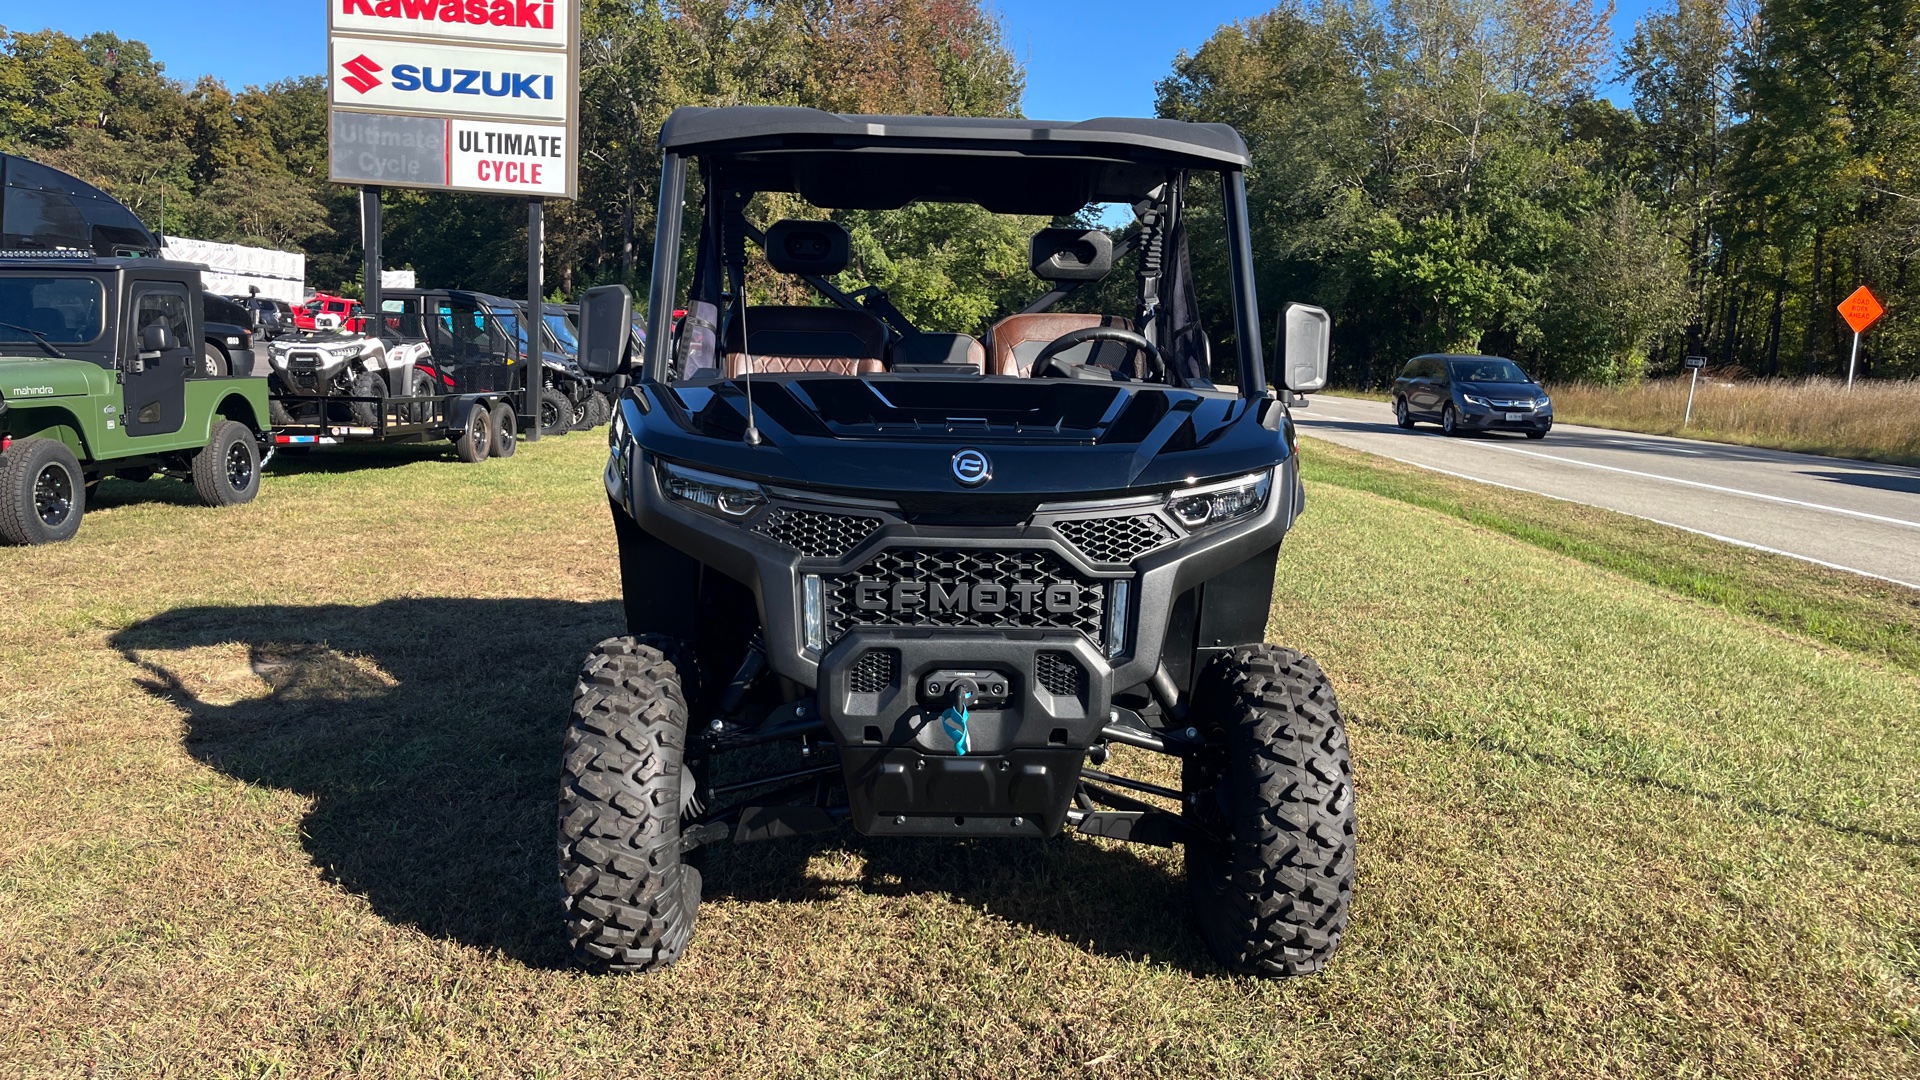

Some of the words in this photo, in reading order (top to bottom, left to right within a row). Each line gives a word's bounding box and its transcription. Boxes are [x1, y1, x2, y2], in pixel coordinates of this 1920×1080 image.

[342, 0, 554, 29] Kawasaki
[391, 64, 554, 100] SUZUKI
[340, 123, 440, 150] Ultimate
[459, 130, 562, 158] ULTIMATE
[358, 151, 421, 177] Cycle
[478, 159, 543, 184] CYCLE
[13, 386, 54, 395] mahindra
[855, 582, 1080, 613] CFMOTO
